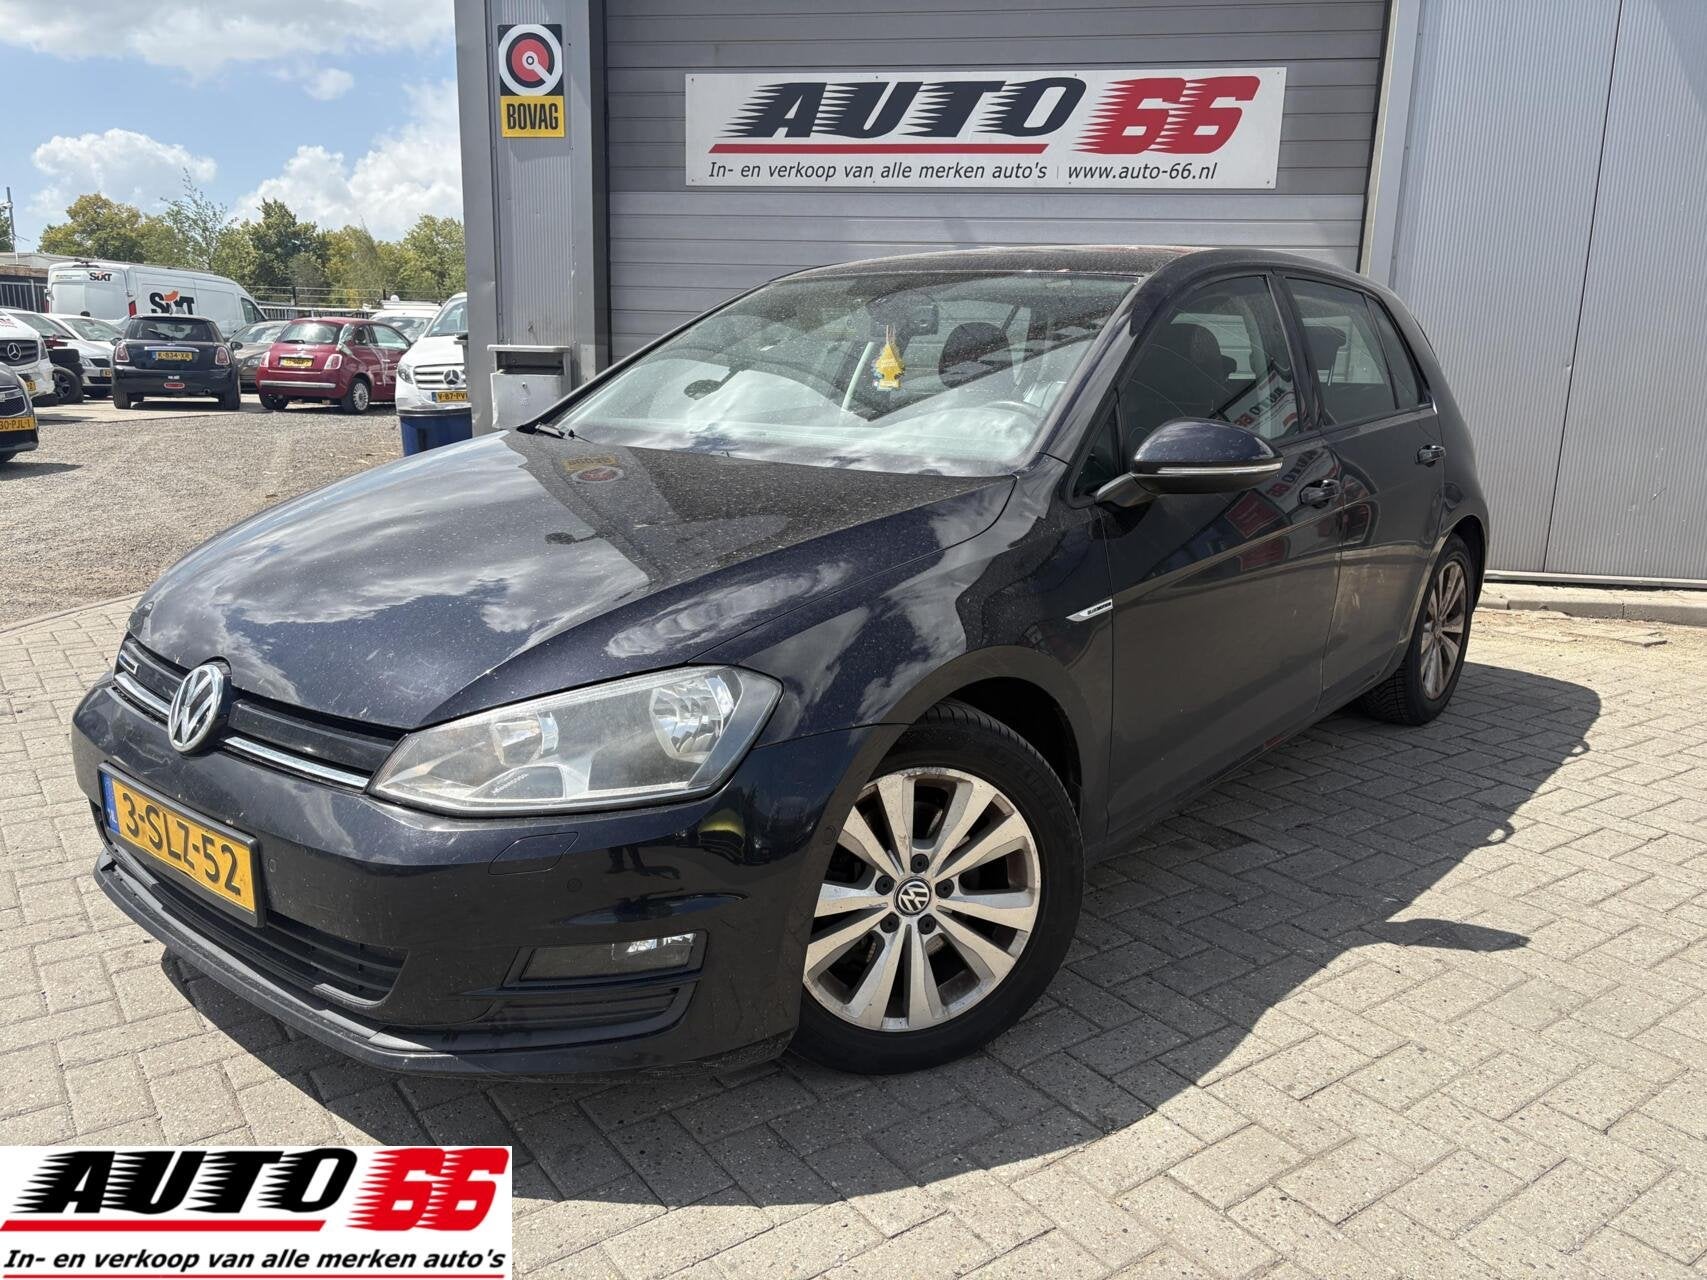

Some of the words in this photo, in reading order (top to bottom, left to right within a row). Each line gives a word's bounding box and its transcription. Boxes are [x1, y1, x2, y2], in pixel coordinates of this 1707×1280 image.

[506, 103, 559, 130] BOVAG
[712, 77, 1087, 138] AUTO
[1070, 76, 1261, 154] 66
[708, 161, 734, 178] In-
[740, 165, 761, 178] en
[768, 161, 837, 182] verkoop
[844, 165, 874, 178] van
[880, 161, 912, 179] alle
[918, 162, 985, 179] merken
[992, 161, 1048, 179] auto's
[1068, 162, 1218, 180] www.auto-66.nl
[122, 792, 242, 897] 3-SLZ-52
